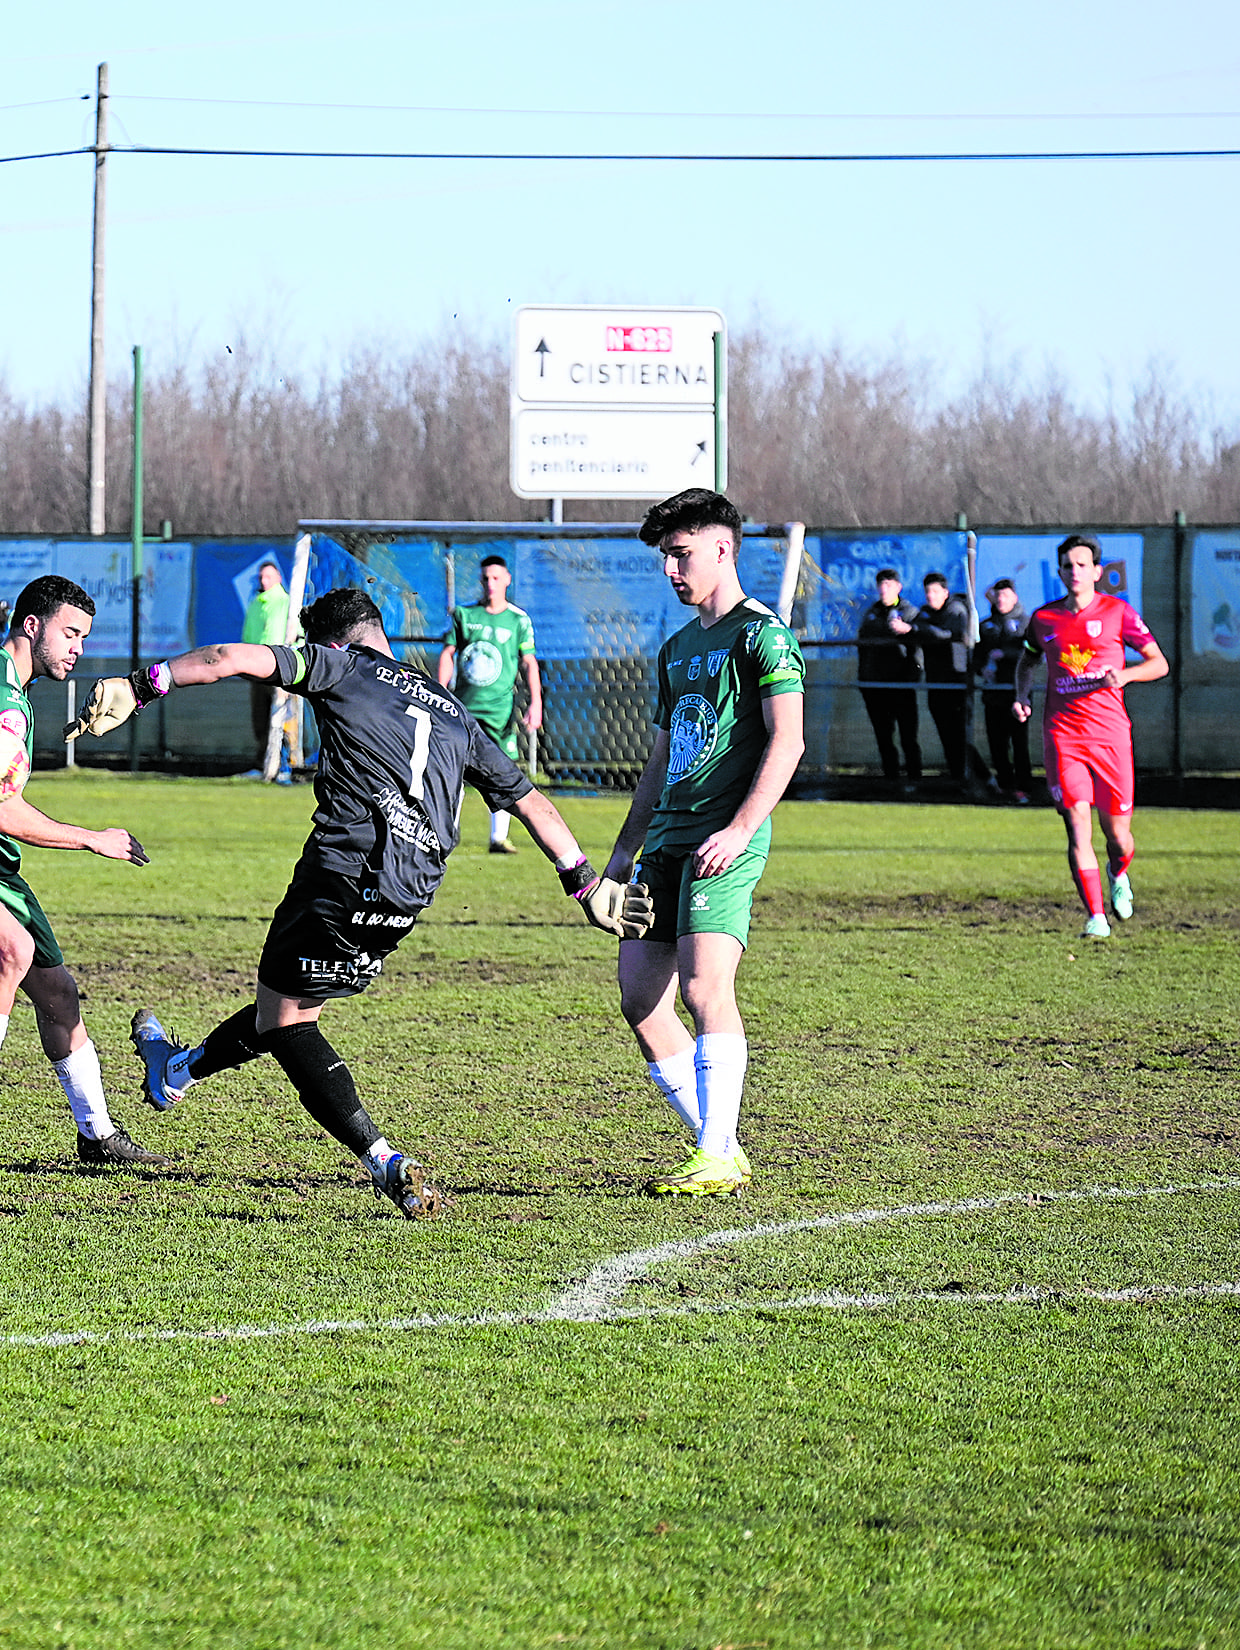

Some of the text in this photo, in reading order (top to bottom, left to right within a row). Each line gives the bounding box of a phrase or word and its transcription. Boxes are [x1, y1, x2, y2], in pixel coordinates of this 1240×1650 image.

[607, 327, 671, 351] N-625
[569, 363, 709, 385] CISTIERNA
[375, 666, 402, 687] El
[403, 704, 432, 801] 1
